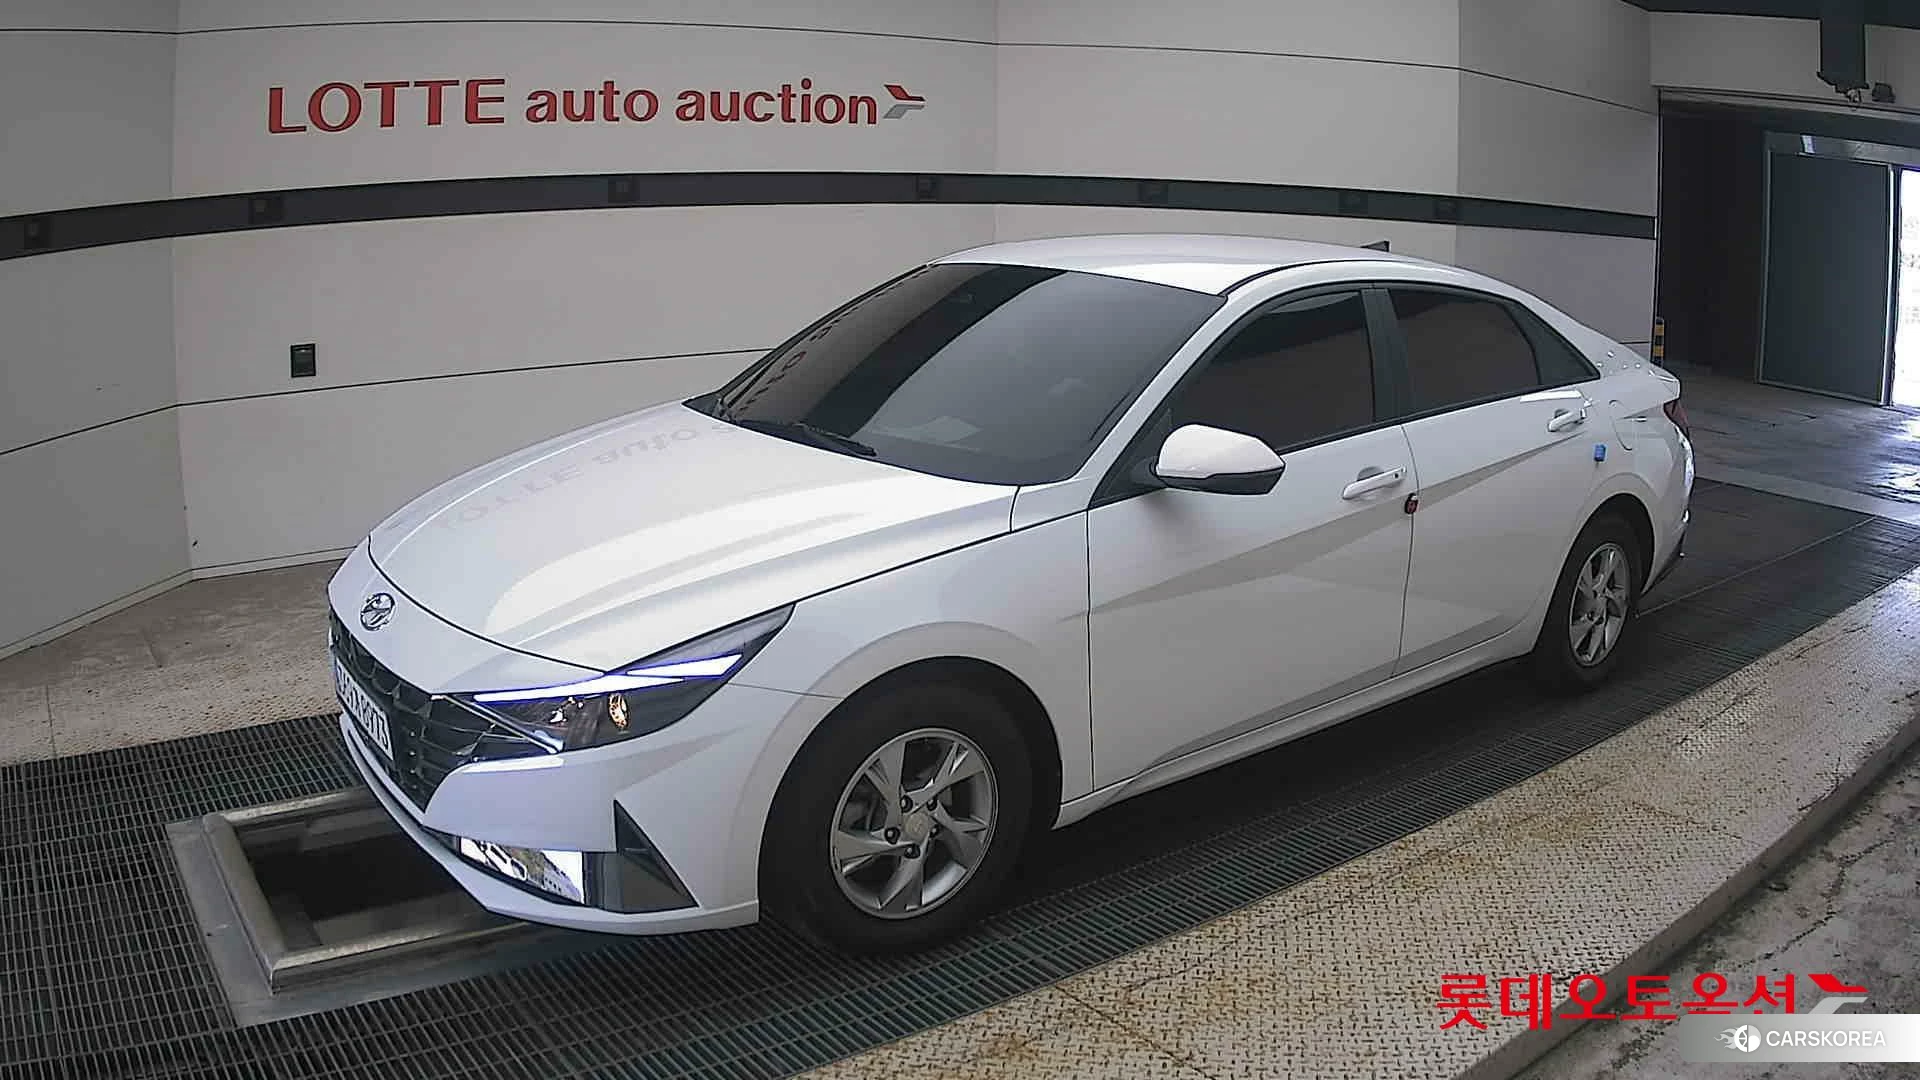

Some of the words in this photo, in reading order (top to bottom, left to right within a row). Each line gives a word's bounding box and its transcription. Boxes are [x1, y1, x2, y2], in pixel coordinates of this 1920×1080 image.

[268, 79, 505, 134] LOTTE
[526, 80, 660, 123] auto
[676, 78, 878, 124] auction
